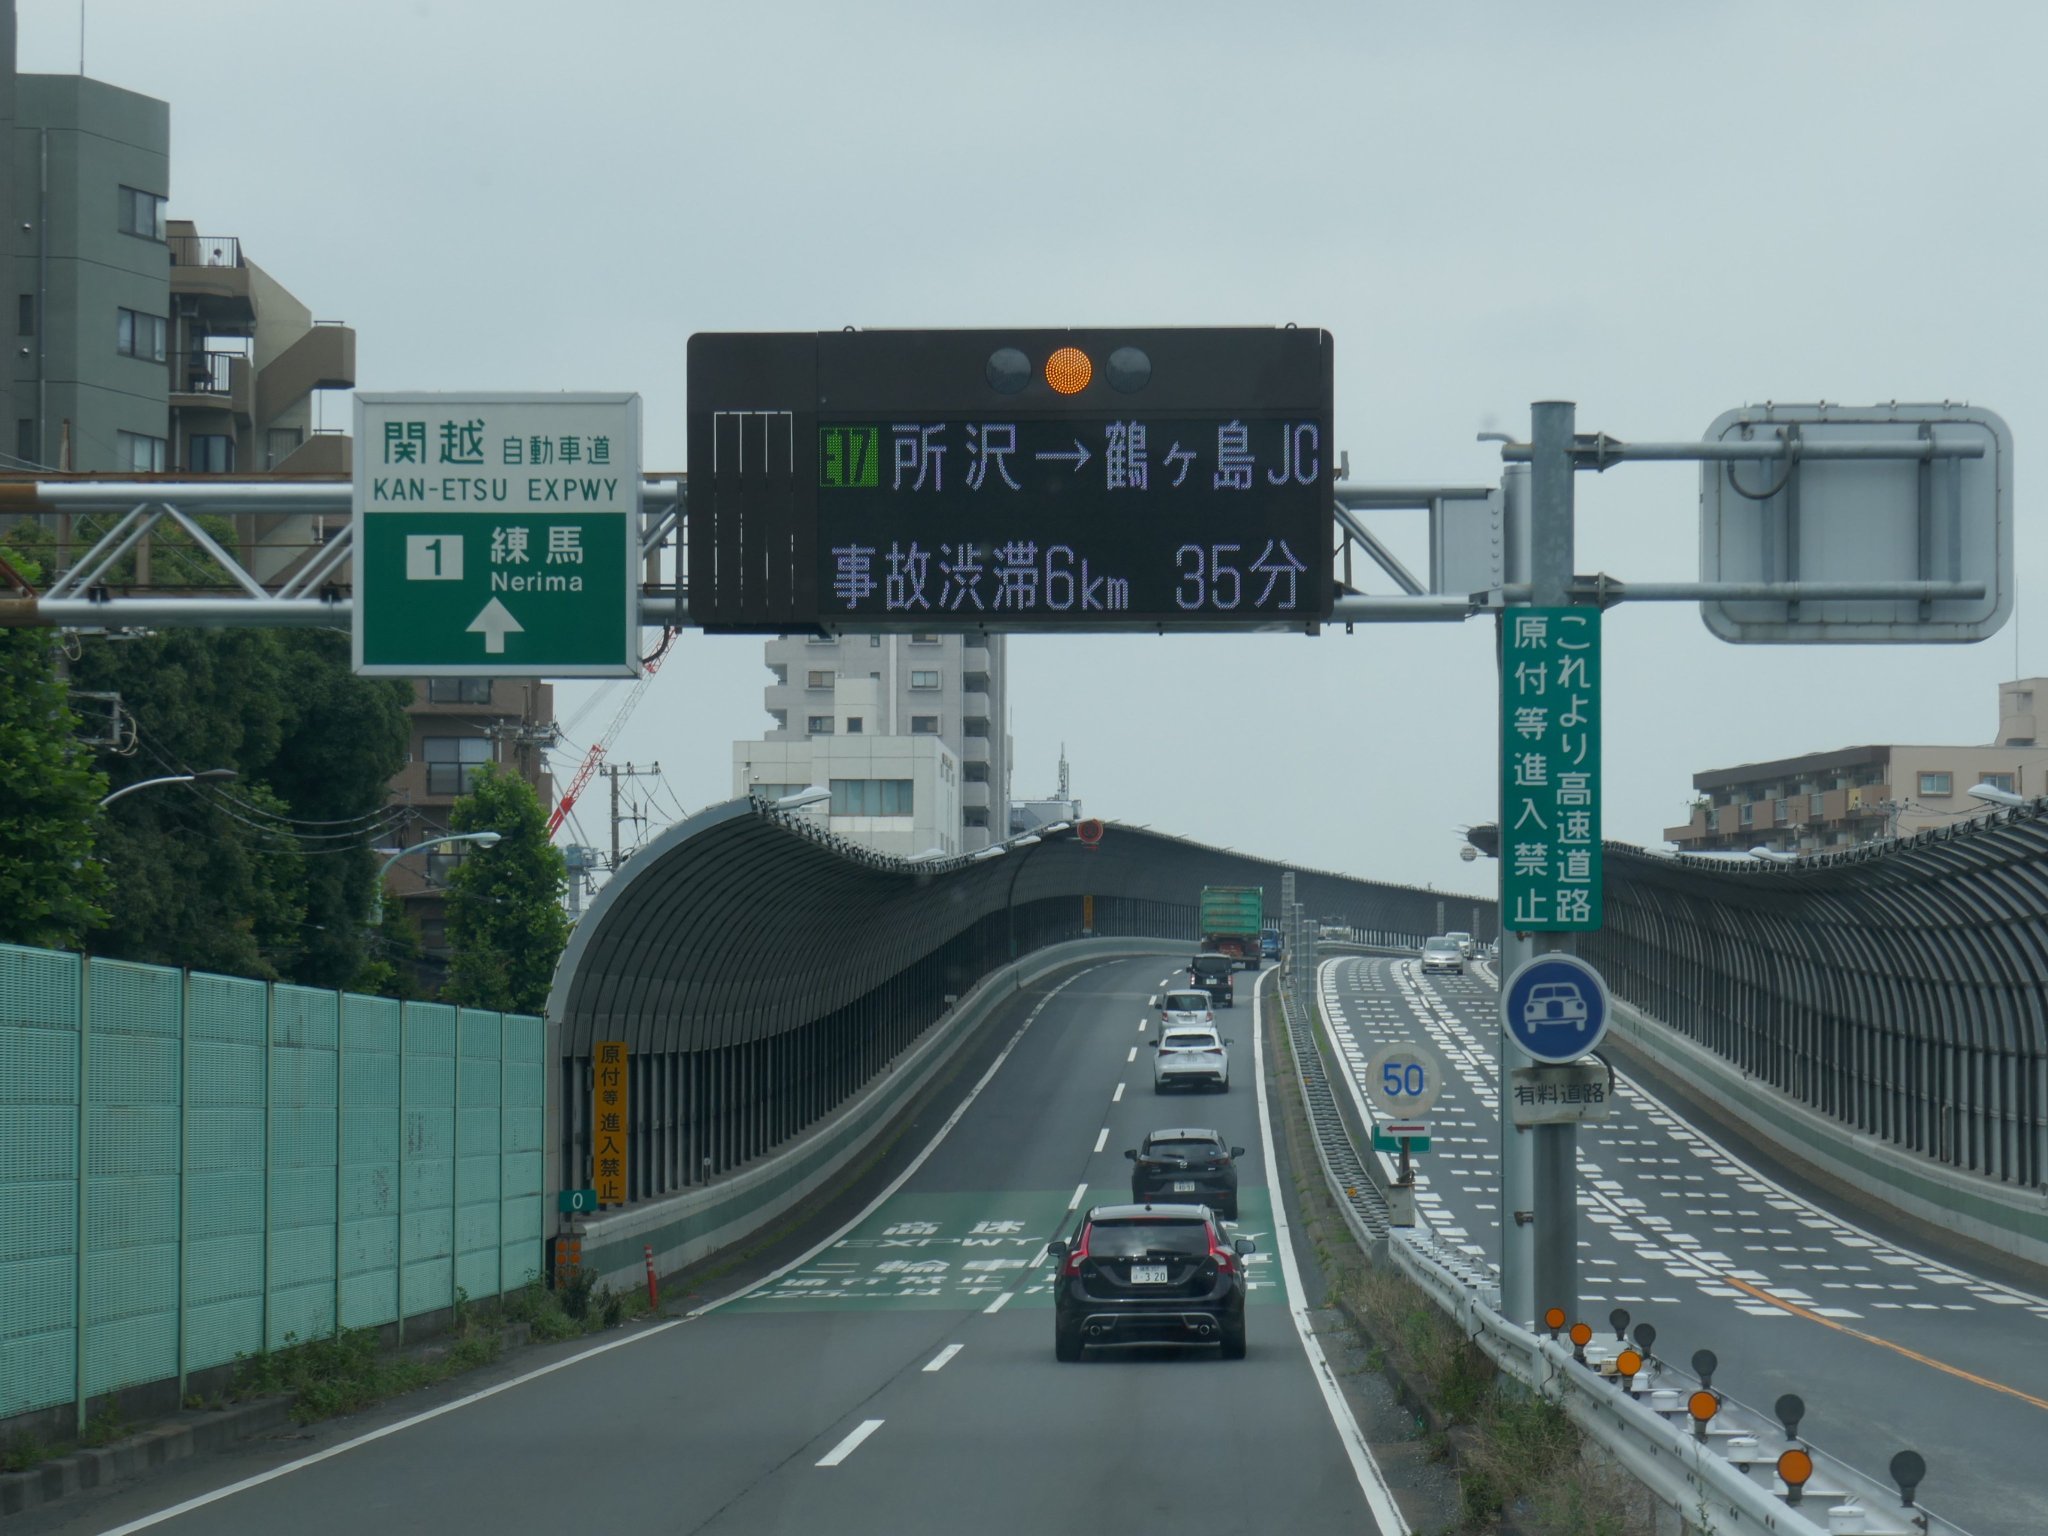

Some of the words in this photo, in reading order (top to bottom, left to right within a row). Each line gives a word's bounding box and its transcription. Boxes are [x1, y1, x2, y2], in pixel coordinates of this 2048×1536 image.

[384, 419, 485, 465] 関越
[503, 435, 611, 465] 自動車道
[820, 428, 875, 486] E17
[891, 422, 1021, 491] 所沢
[373, 478, 507, 501] KAN-ETSU
[528, 478, 618, 501] EXPWY
[425, 538, 442, 576] 1
[490, 526, 584, 564] 練馬
[491, 571, 583, 592] Nerima
[1175, 539, 1307, 611] 35分
[1514, 616, 1549, 922] 原付等進入禁止
[1556, 616, 1591, 922] これより高速道路
[1383, 1063, 1424, 1097] 50
[1514, 1083, 1605, 1106] 有料道路
[600, 1045, 621, 1200] 原付等進入禁止
[833, 1237, 1043, 1248] EXPWY
